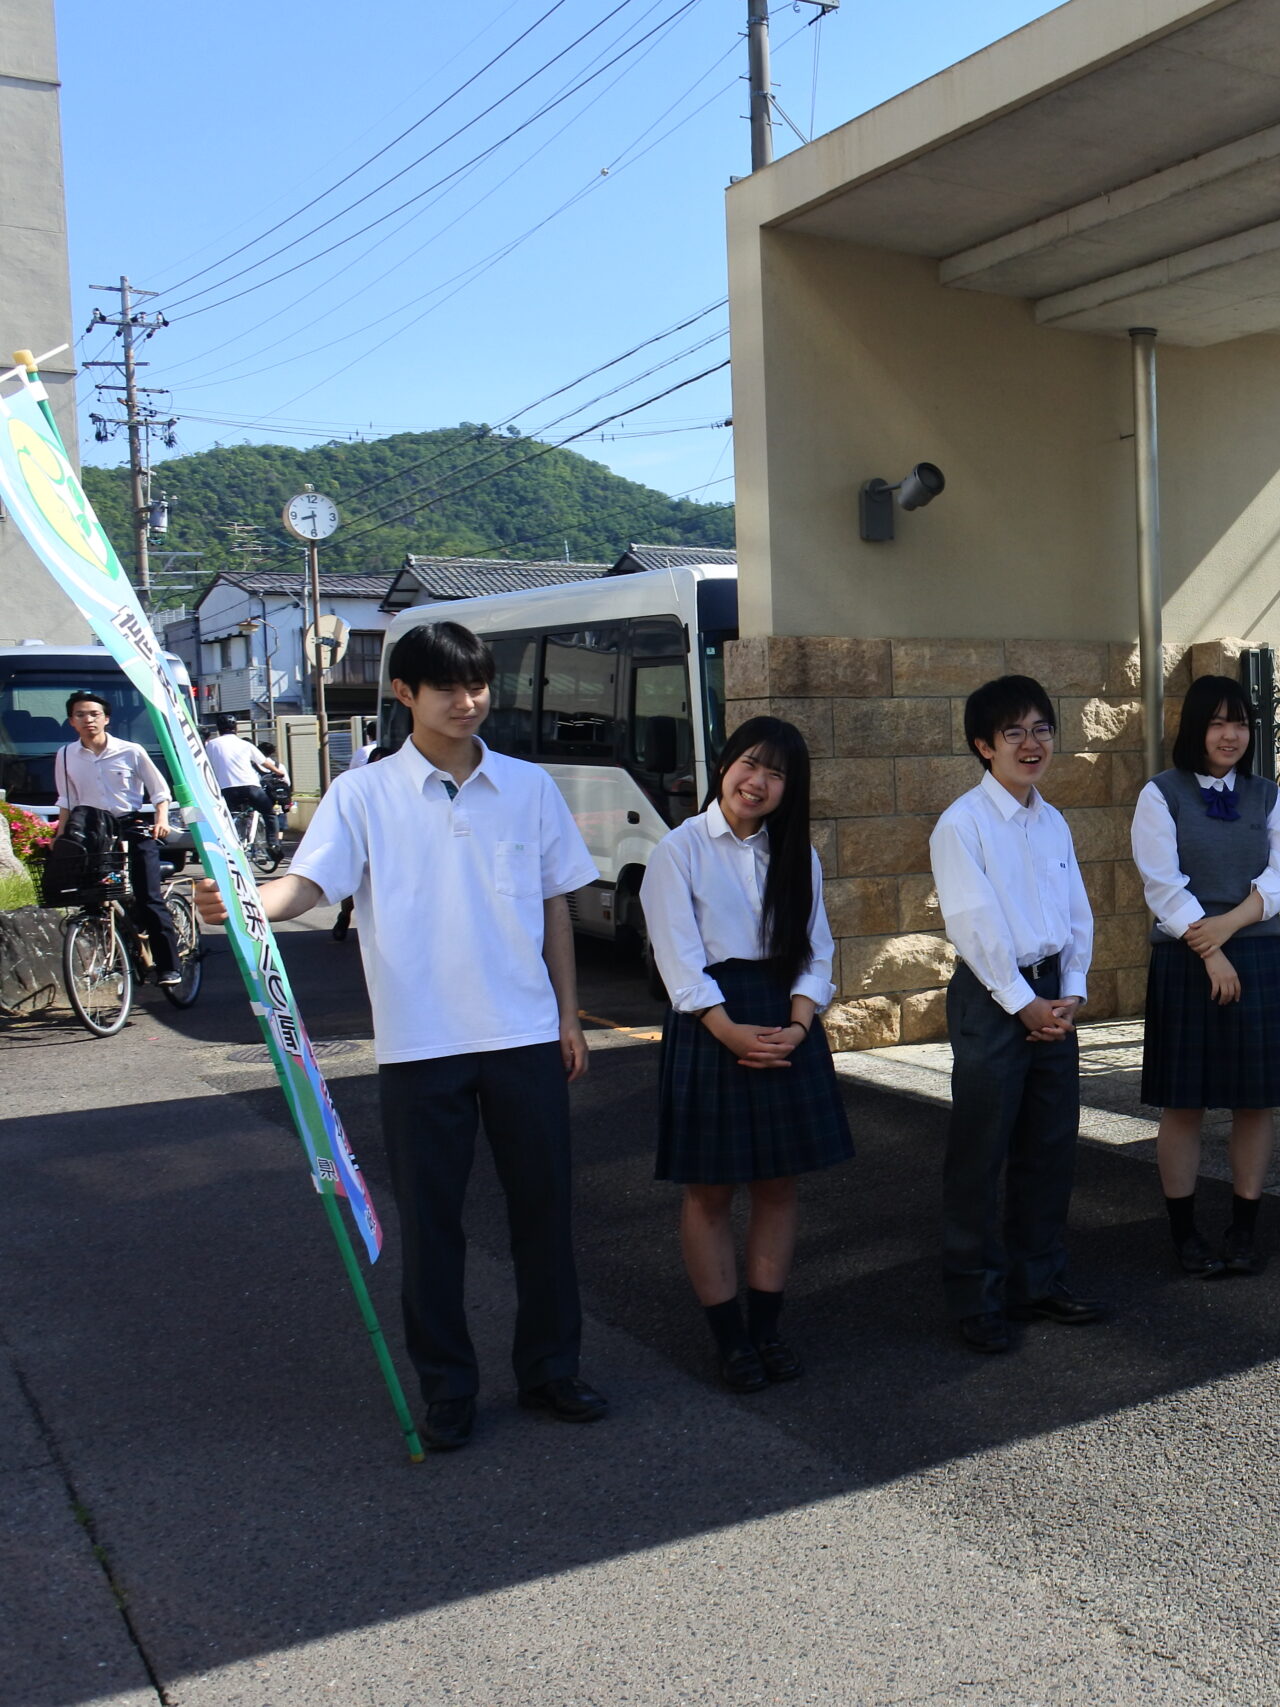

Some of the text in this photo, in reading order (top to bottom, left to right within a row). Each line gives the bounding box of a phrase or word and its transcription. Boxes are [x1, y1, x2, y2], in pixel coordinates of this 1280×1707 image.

[306, 494, 318, 504] 12
[290, 511, 298, 521] 9
[329, 512, 337, 522] 3
[310, 528, 318, 538] 6
